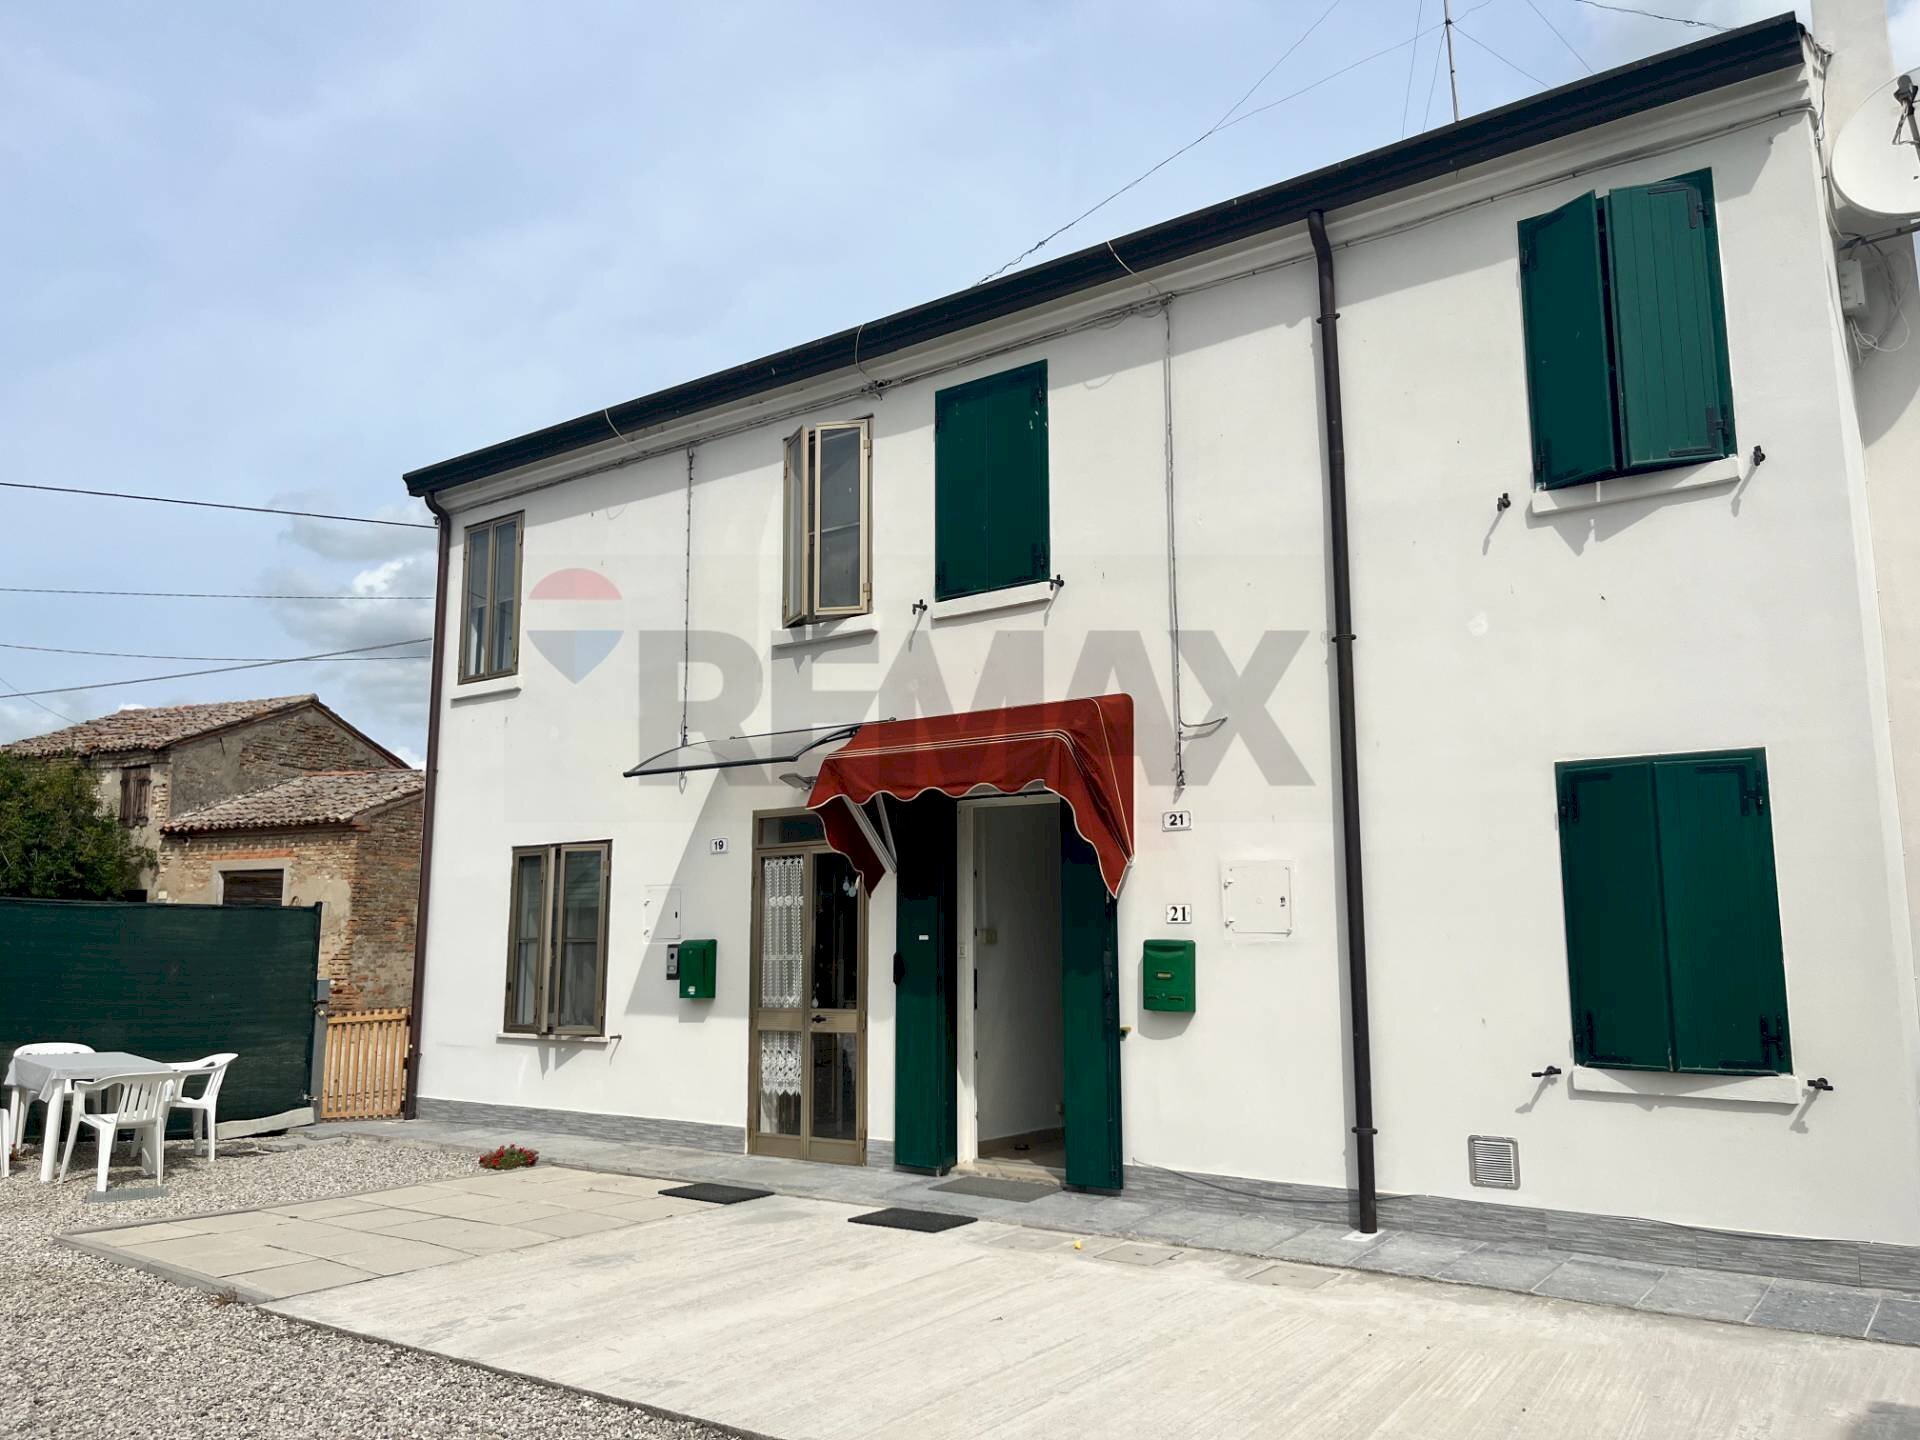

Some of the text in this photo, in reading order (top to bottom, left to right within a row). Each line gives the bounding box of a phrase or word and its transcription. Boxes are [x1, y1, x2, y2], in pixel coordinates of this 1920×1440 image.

[1169, 813, 1184, 826] 21
[713, 839, 724, 851] 19
[1169, 906, 1187, 922] 21
